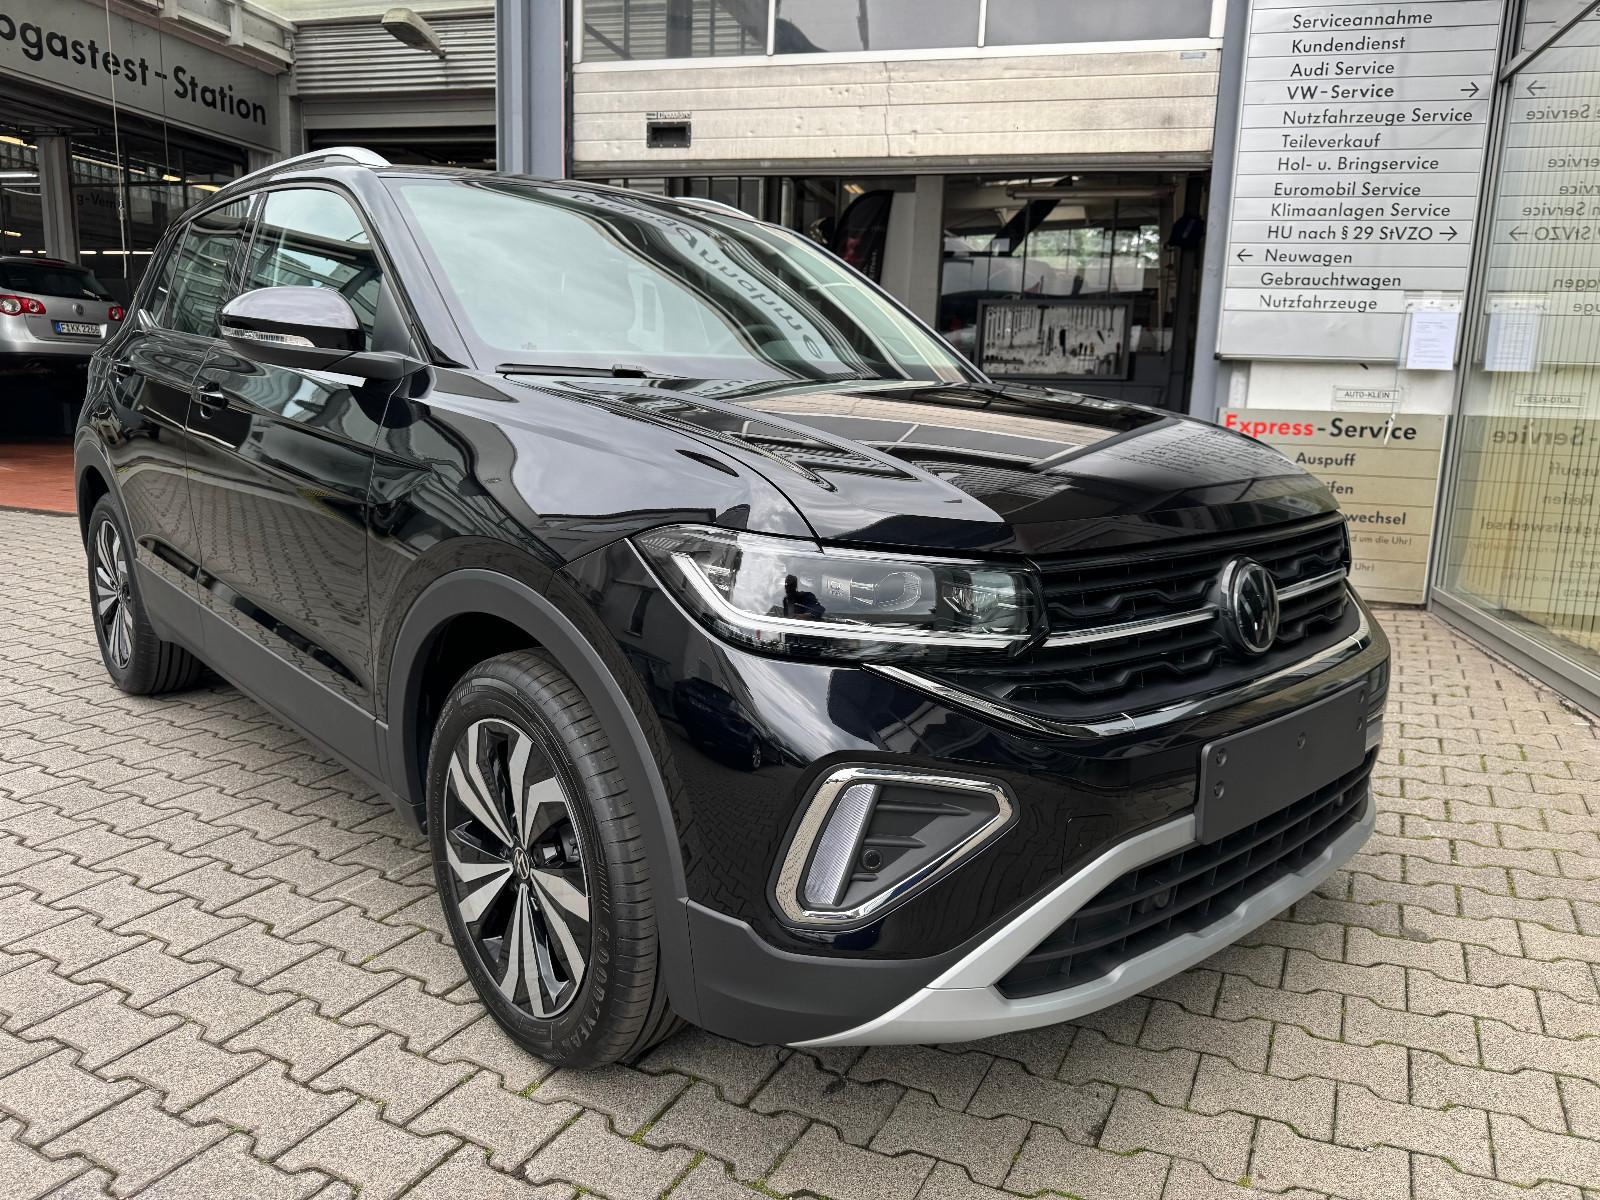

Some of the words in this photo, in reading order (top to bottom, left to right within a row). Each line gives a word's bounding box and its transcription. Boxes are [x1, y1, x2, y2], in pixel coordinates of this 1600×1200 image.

[1292, 11, 1433, 29] Serviceannahme
[1291, 36, 1406, 54] Kundendienst
[1290, 61, 1330, 77] Audi
[1334, 61, 1395, 76] Service
[1286, 83, 1395, 99] VW-Service
[1282, 108, 1406, 126] Nutzfahrzeuge
[1411, 107, 1473, 122] Service
[1281, 132, 1382, 149] Teileverkauf
[1277, 156, 1312, 171] Hol-
[1317, 160, 1332, 171] u.
[1337, 155, 1440, 174] Bringservice
[1273, 181, 1356, 197] Euromobil
[1361, 181, 1422, 197] Service
[1270, 201, 1385, 220] Klimaanlagen
[1389, 202, 1451, 217] Service
[1266, 225, 1293, 240] HU
[1297, 225, 1337, 240] nach
[1340, 225, 1349, 241] §
[1353, 225, 1375, 241] 29
[1378, 225, 1434, 241] StVZO
[1264, 248, 1353, 266] Neuwagen
[1260, 271, 1402, 289] Gebrauchtwagen
[1259, 295, 1378, 312] Nutzfahrzeuge
[1344, 391, 1391, 399] AUTO-KLEIN
[1295, 452, 1357, 469] Auspuff
